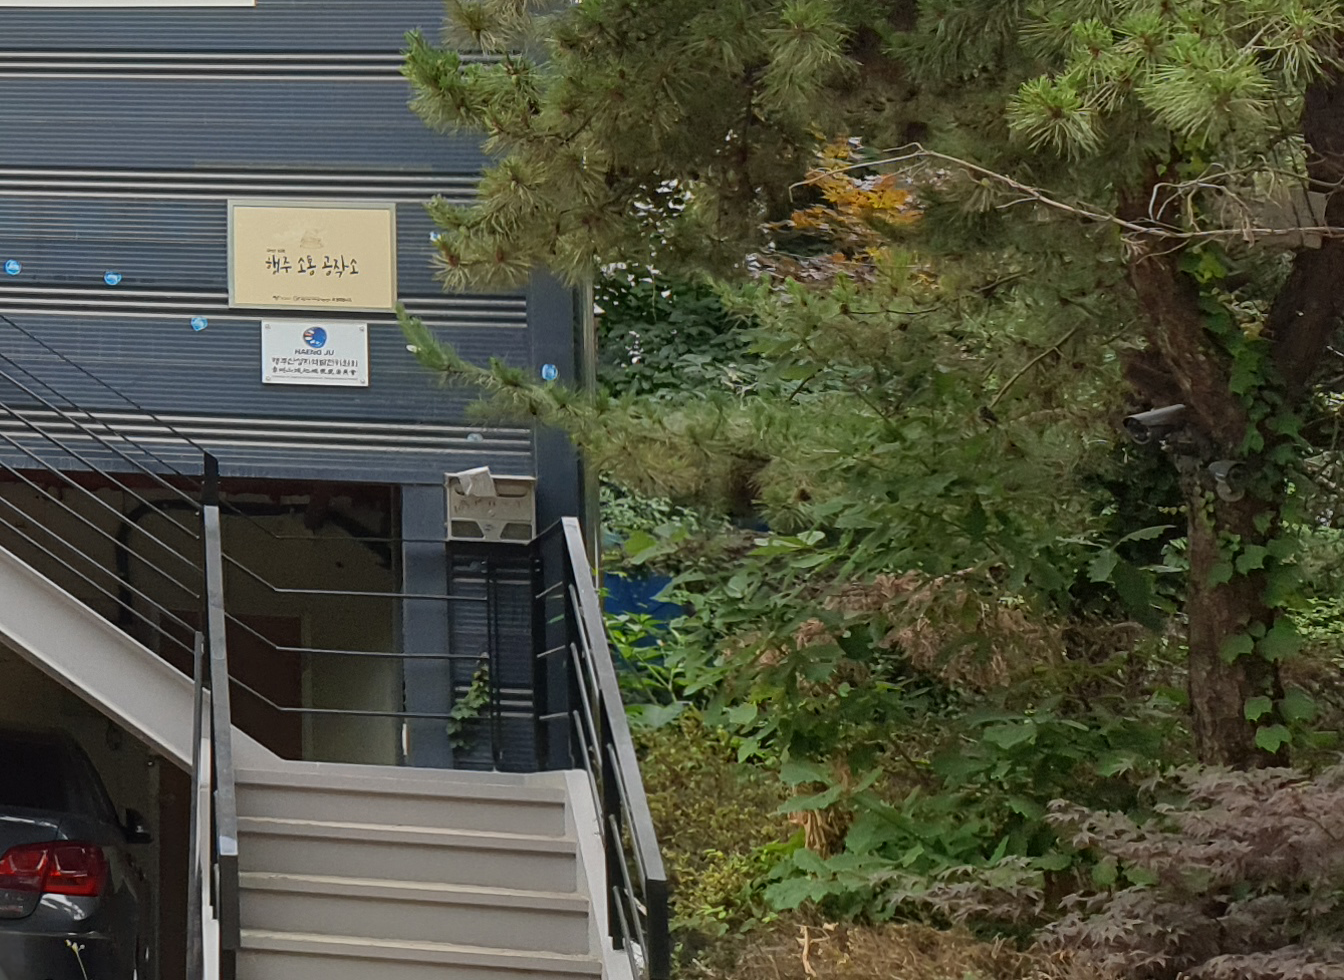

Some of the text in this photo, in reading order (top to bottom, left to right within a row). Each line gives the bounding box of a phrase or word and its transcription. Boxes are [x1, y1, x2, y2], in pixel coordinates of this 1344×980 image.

[265, 254, 359, 278] 행주 소통 공작소
